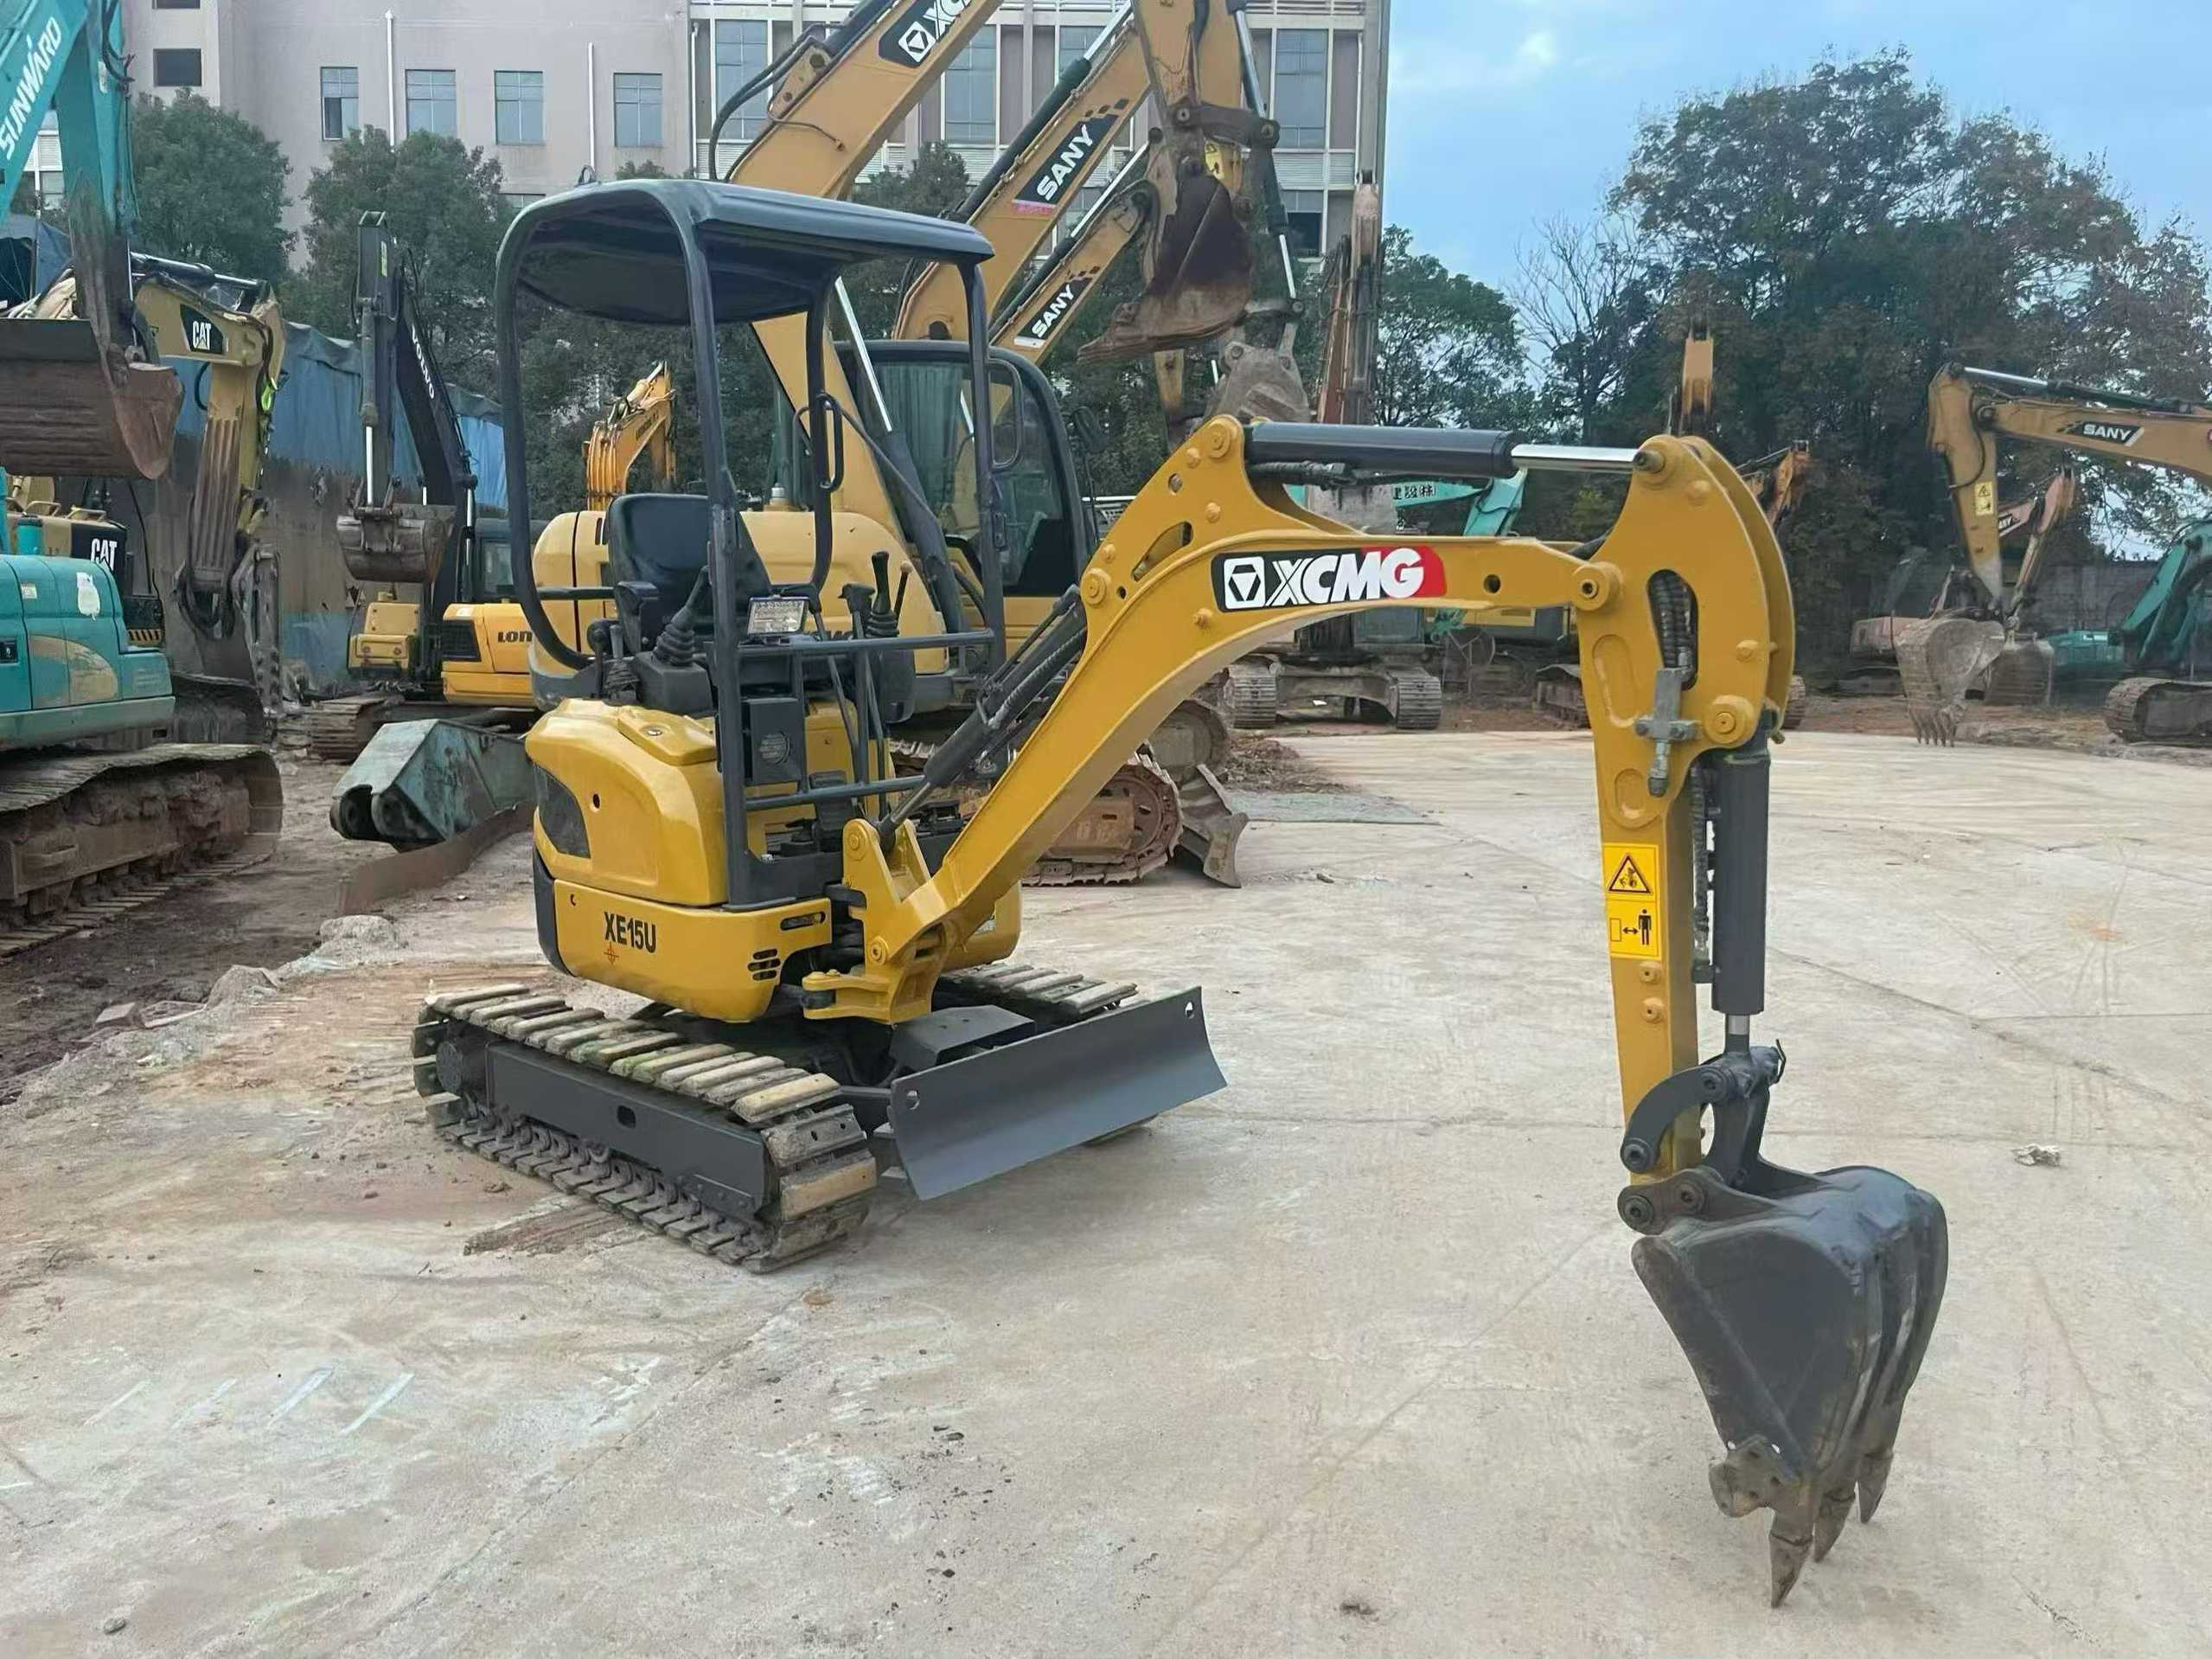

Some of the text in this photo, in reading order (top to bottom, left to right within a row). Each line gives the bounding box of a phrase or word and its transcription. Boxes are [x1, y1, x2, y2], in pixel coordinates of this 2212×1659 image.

[0, 16, 62, 160] SUNWARD
[1037, 124, 1093, 201] SANY
[192, 320, 212, 350] CAT
[1032, 284, 1074, 338] SANY
[411, 323, 435, 399] VOLVO
[2083, 423, 2132, 441] SANY
[90, 537, 118, 572] CAT
[1264, 548, 1424, 607] XCMG
[604, 911, 656, 954] XE15U
